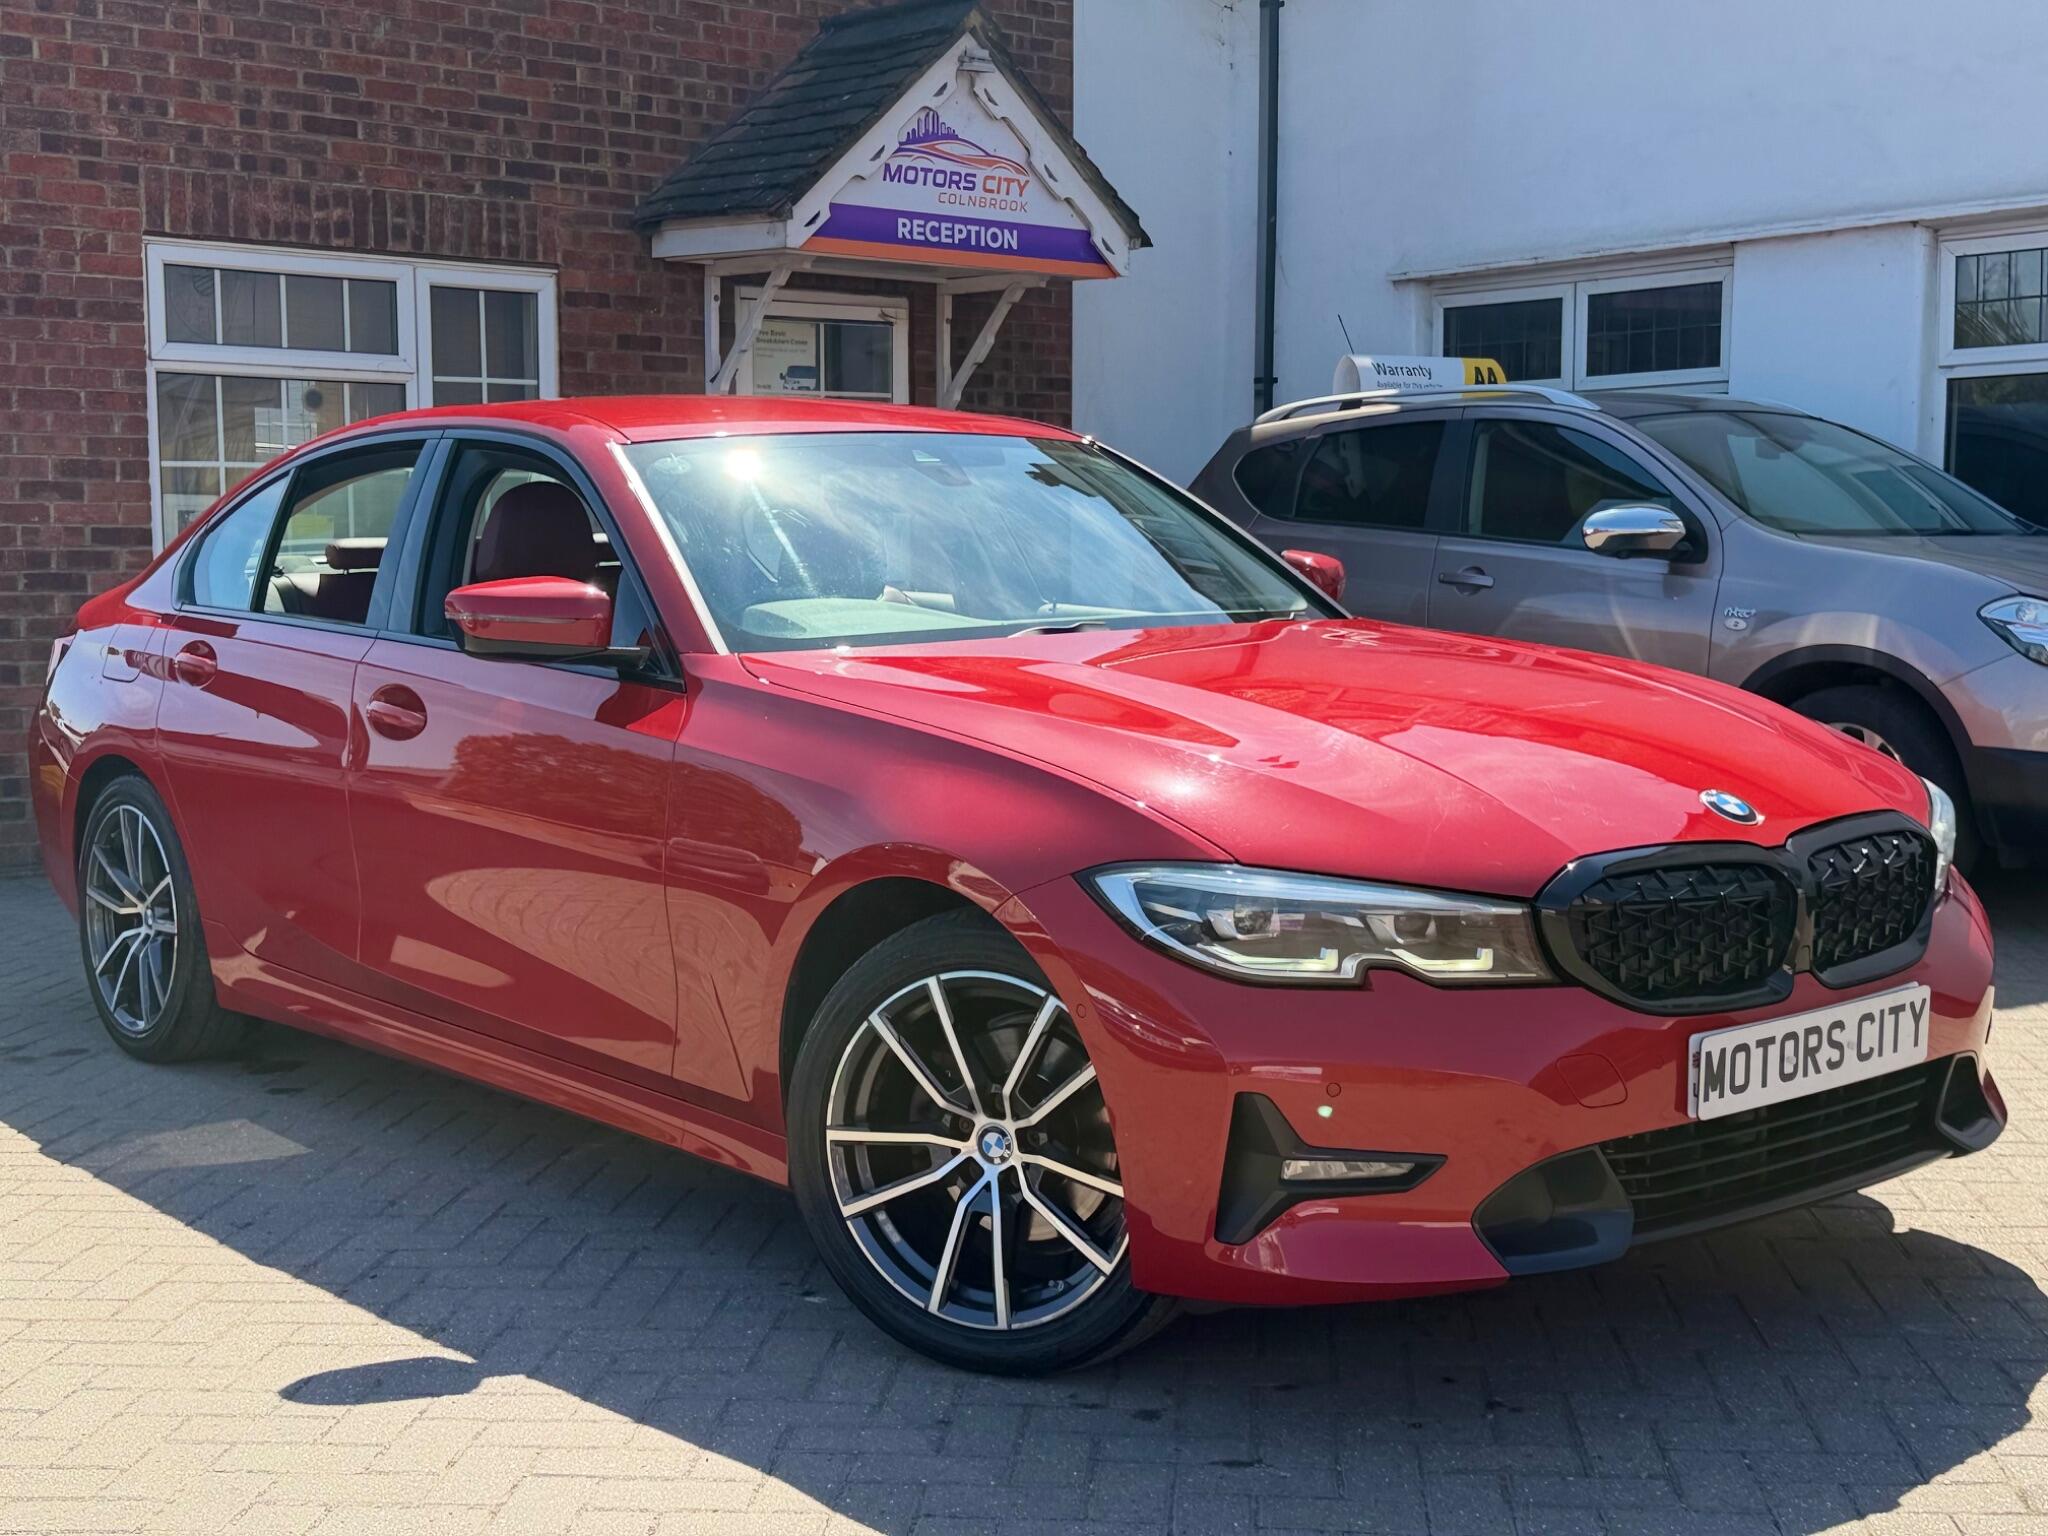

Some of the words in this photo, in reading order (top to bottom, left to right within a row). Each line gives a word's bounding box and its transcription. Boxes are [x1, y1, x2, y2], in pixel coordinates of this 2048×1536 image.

[883, 163, 977, 191] MOTORS
[982, 176, 1030, 197] CITY
[938, 192, 1029, 213] COLNBROOK
[897, 217, 1018, 250] RECEPTION
[1371, 361, 1432, 381] Warranty
[1474, 366, 1499, 385] AA
[1703, 1019, 1846, 1103] MOTORS
[1856, 997, 1927, 1063] CITY
